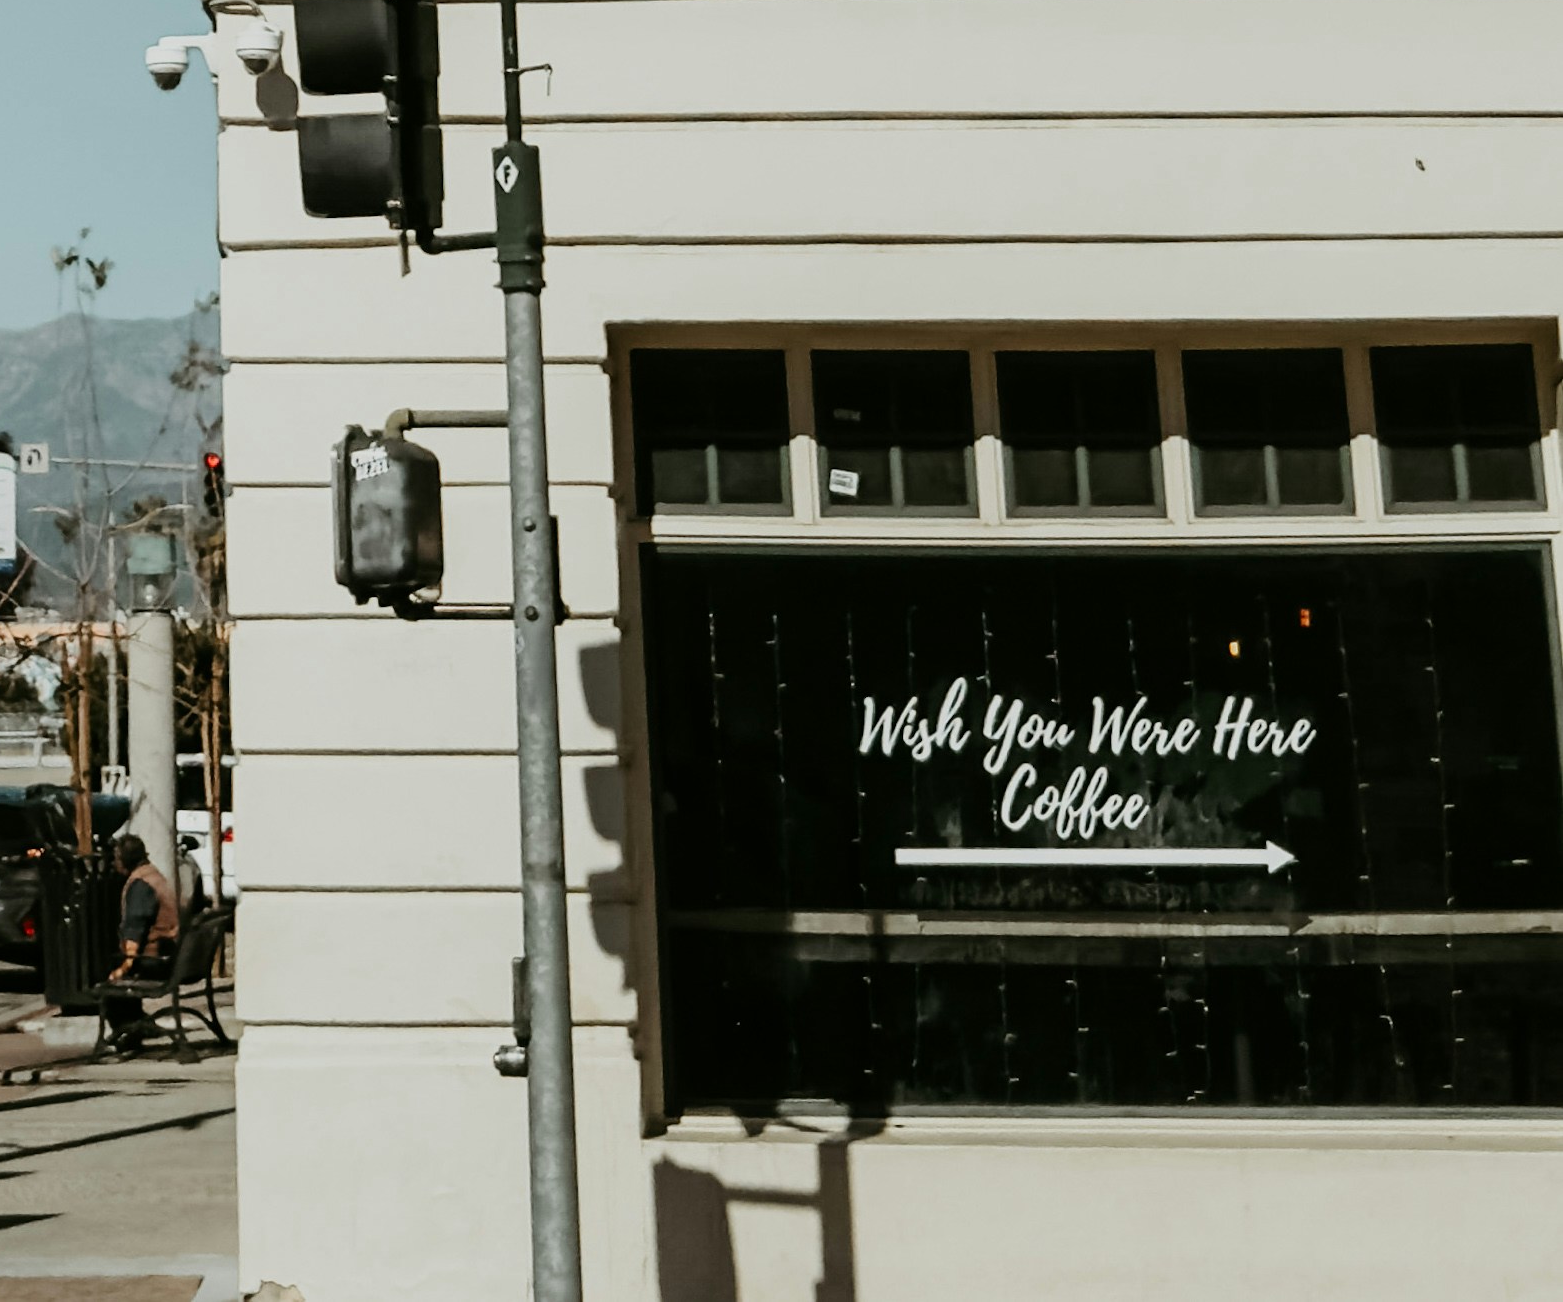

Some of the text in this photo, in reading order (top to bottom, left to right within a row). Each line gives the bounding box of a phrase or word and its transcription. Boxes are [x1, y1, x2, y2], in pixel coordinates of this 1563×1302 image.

[860, 677, 1317, 775] Wish You Were Here
[1000, 763, 1150, 839] Coffee
